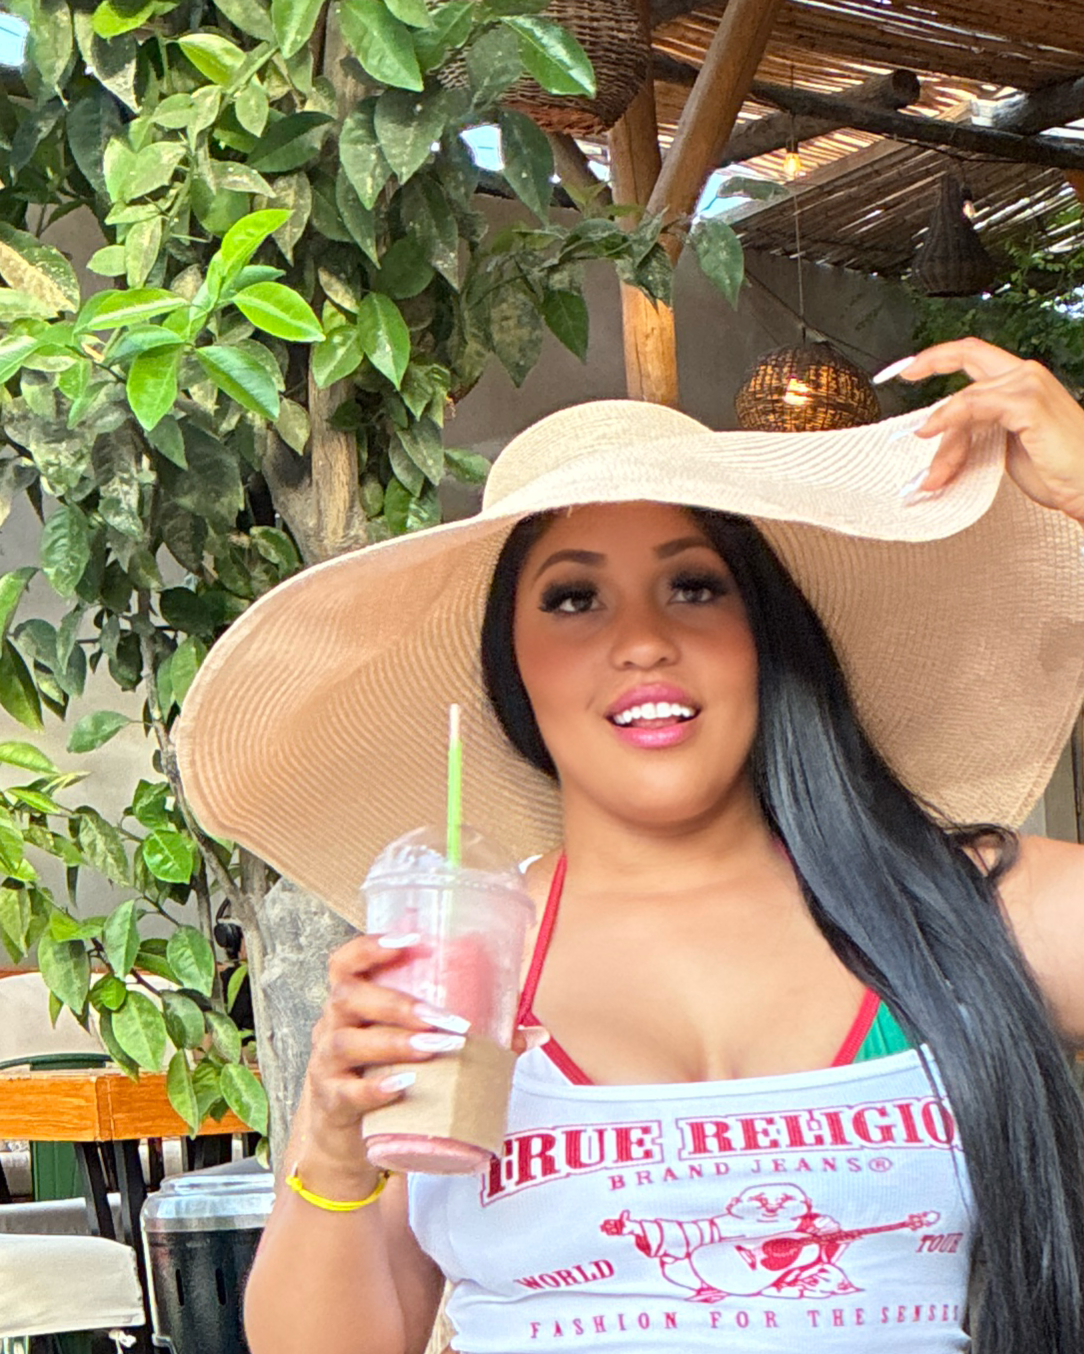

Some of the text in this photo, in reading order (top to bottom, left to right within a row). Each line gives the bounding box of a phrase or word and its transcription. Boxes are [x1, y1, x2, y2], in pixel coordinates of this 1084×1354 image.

[608, 1161, 730, 1191] BRAND
[513, 1258, 615, 1290] WORLD
[530, 1311, 678, 1339] FASHION
[709, 1309, 780, 1330] FOR
[807, 1307, 865, 1328] THE
